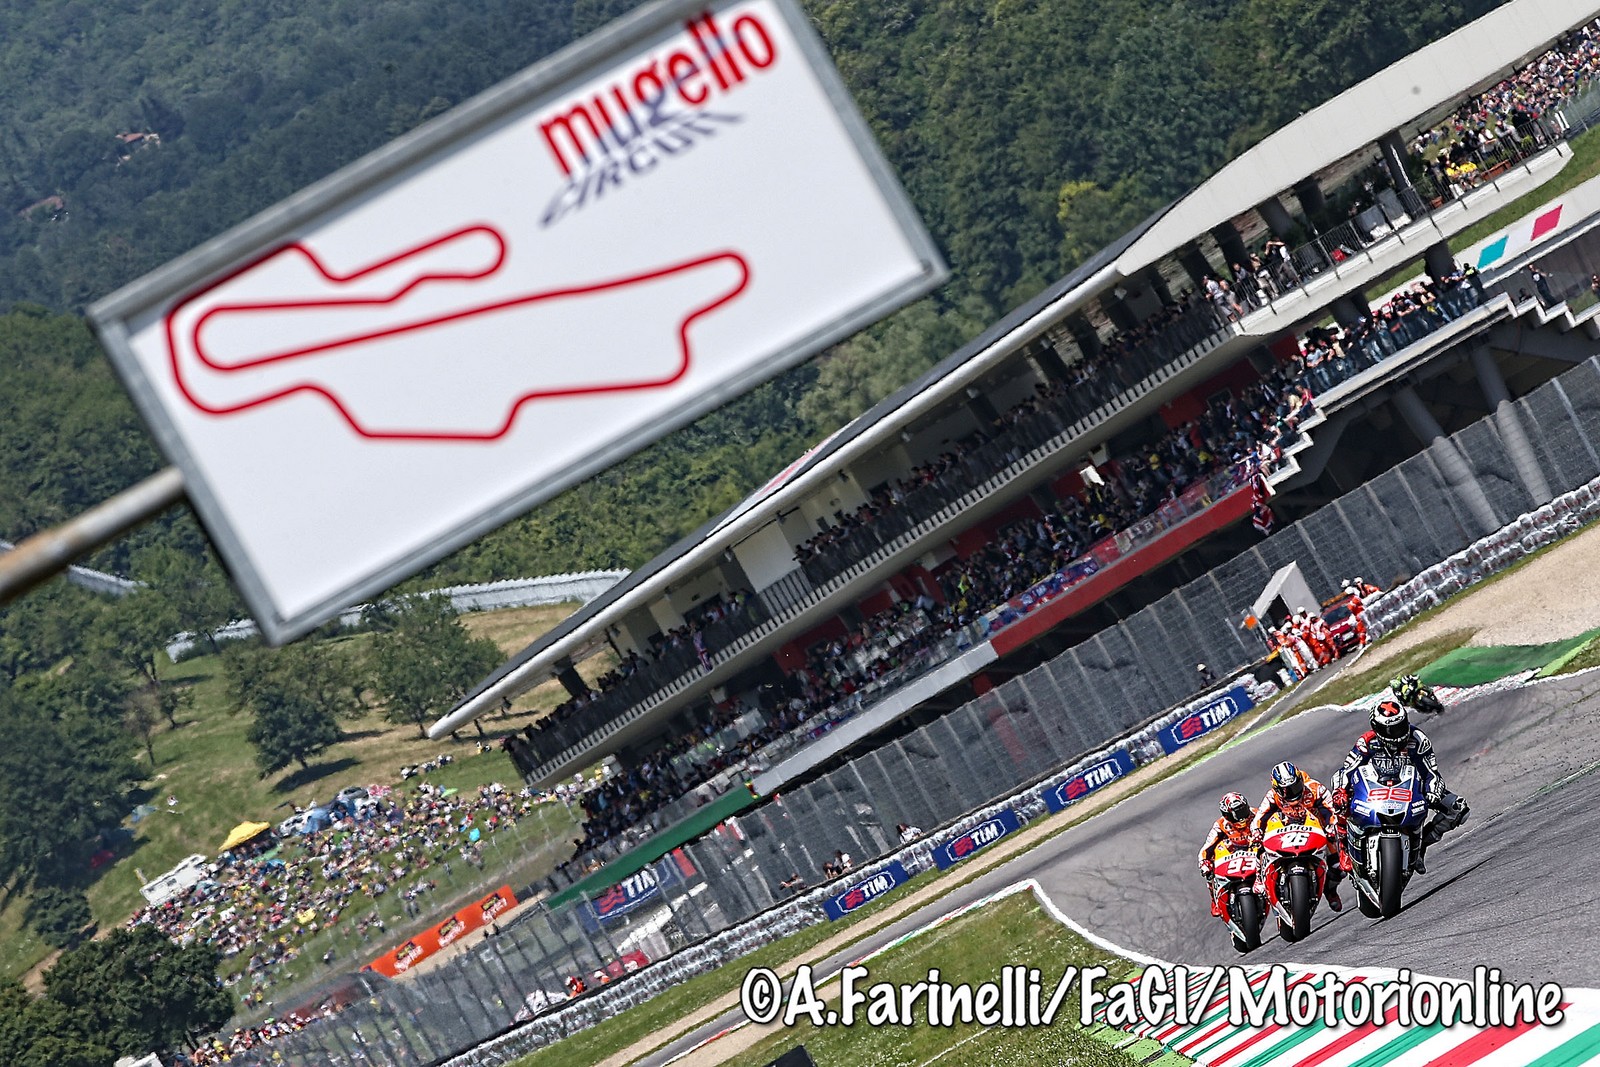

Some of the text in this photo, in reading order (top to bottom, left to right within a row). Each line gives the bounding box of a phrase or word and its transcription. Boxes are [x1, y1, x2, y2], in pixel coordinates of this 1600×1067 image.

[539, 12, 777, 178] mugello
[1201, 697, 1231, 728] TIM
[1084, 763, 1115, 789] TIM
[1367, 787, 1414, 803] 99
[970, 823, 999, 847] TIM
[1281, 831, 1311, 849] 26
[1226, 858, 1258, 875] 93
[864, 874, 889, 898] TIM
